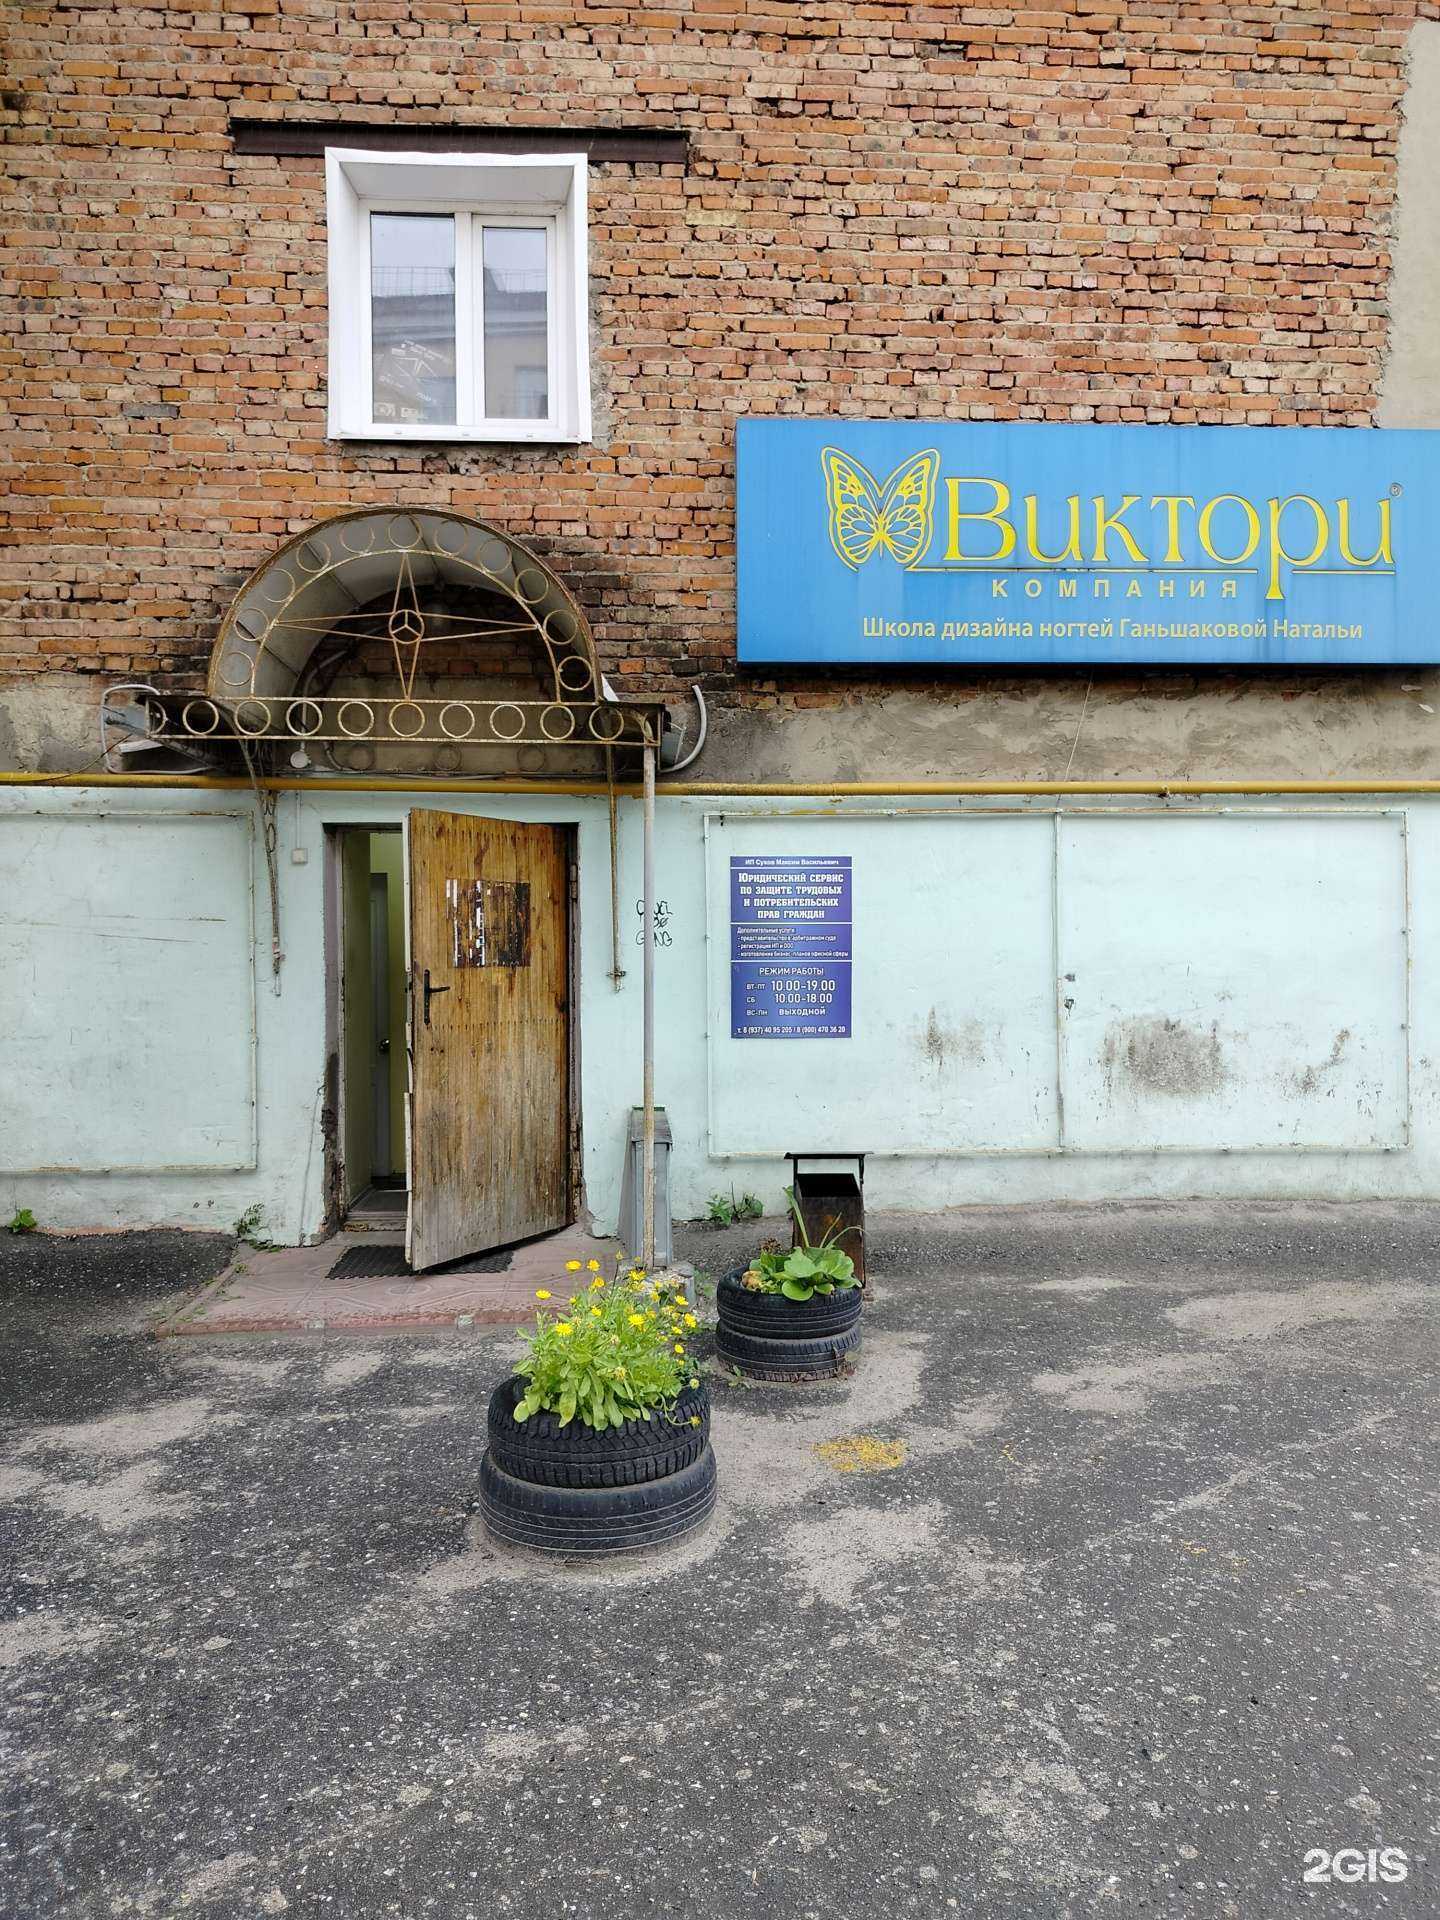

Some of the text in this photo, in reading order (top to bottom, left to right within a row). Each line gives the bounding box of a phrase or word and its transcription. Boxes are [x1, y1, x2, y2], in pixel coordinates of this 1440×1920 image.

[992, 579, 1237, 598] КОМПАНИЯ
[863, 617, 1362, 640] Школа дизайна ногтей Ганьшаковой Натальи
[740, 886, 842, 895] ПО ЗАЩИТЕ ТРУДОВЫХ
[754, 899, 839, 907] ПОТРЕБИТЕЛЬСКИХ
[757, 911, 825, 919] ПРАВ ГРАЖДАН
[771, 980, 836, 991] 10.00-19.00
[775, 993, 833, 1003] 10.00-18.00
[779, 1007, 826, 1016] ВЫХОДНОЙ
